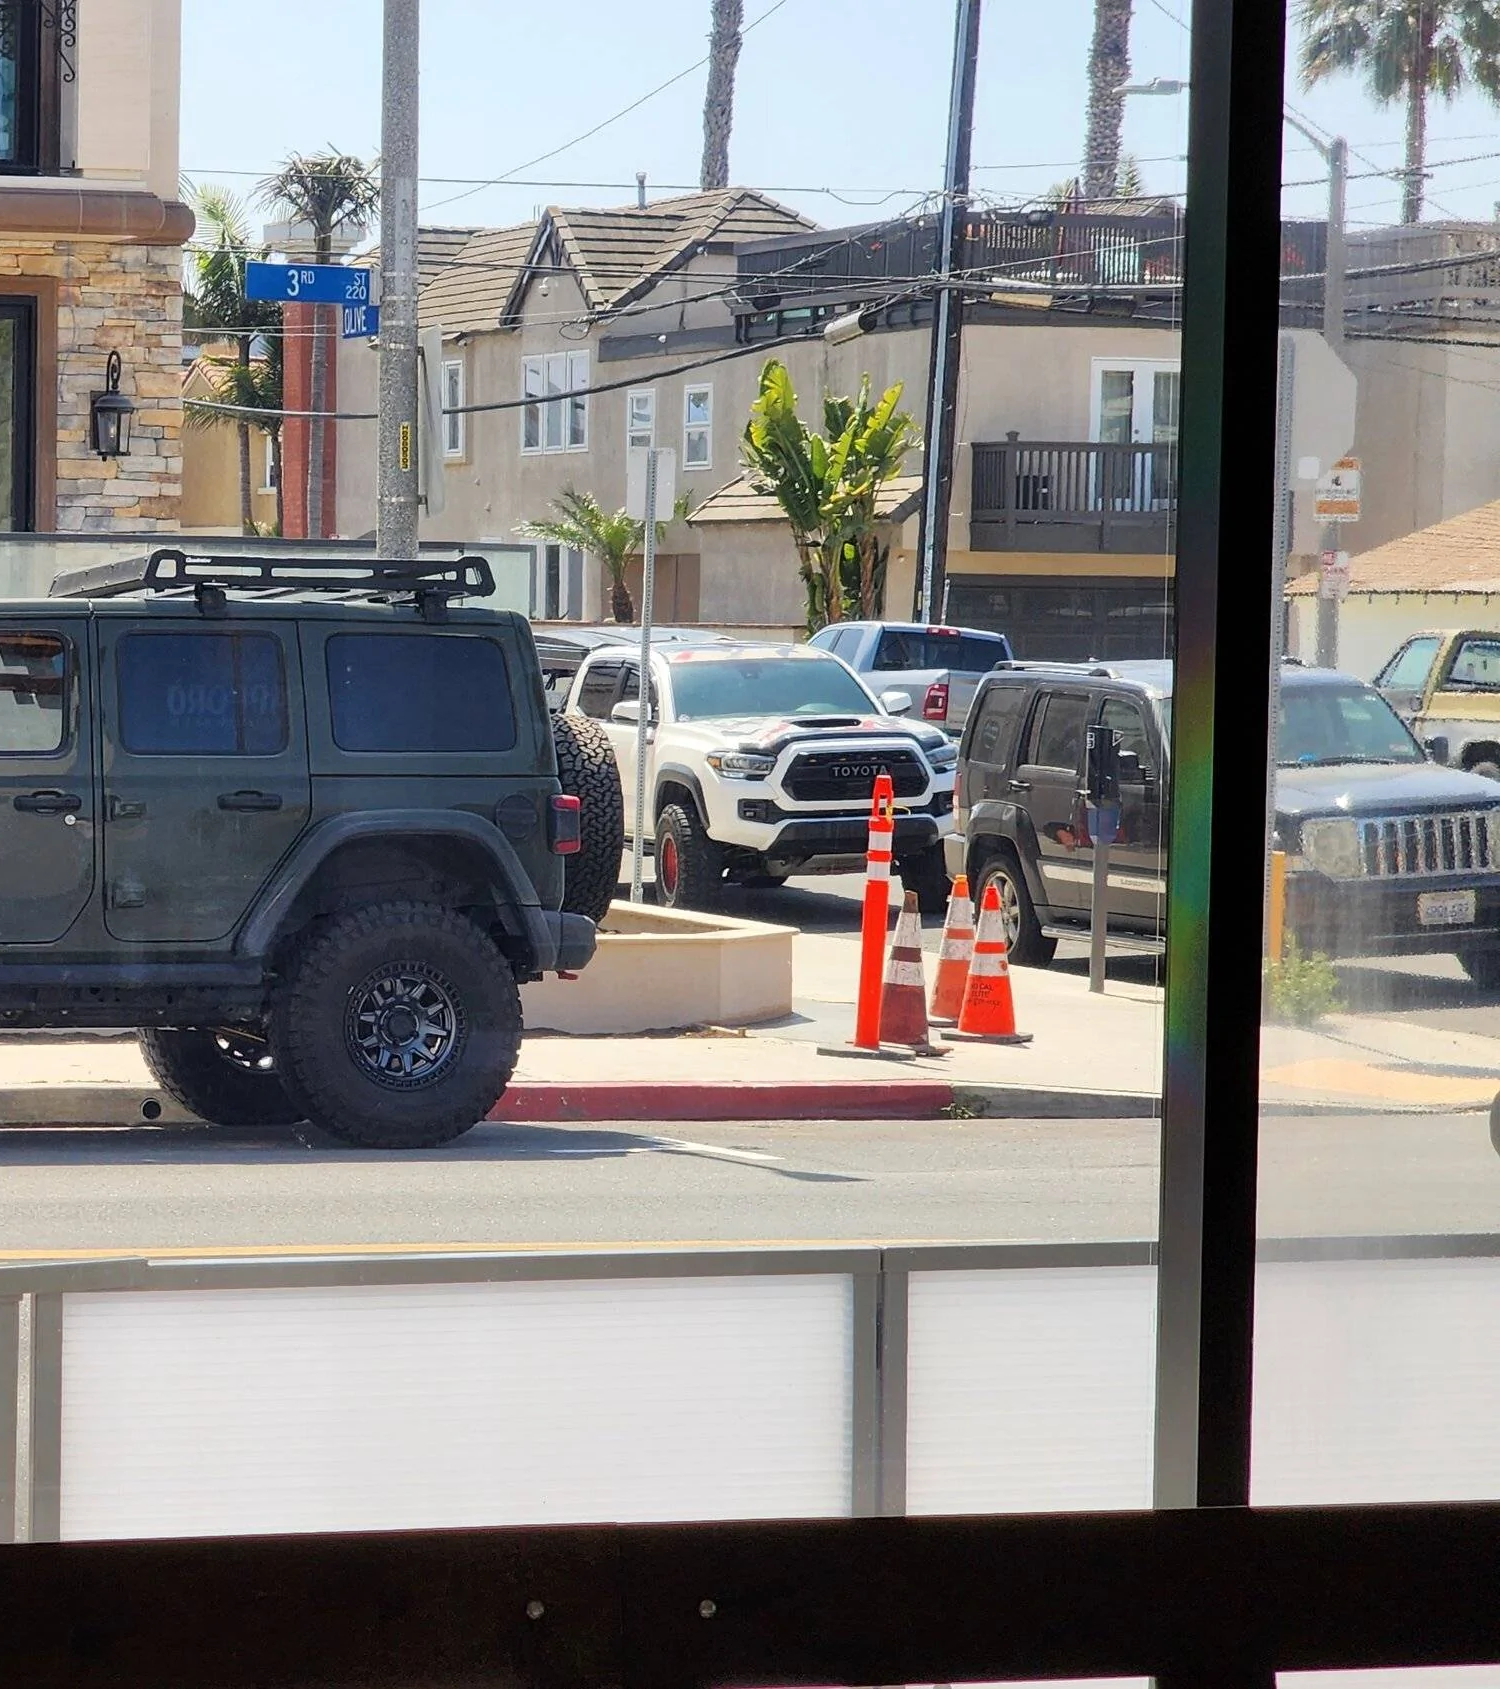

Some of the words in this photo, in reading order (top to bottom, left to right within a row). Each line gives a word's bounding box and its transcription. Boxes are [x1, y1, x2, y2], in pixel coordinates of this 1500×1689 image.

[287, 269, 315, 297] 3RD
[354, 272, 367, 286] ST
[345, 286, 367, 300] 220
[344, 305, 367, 335] OLIVE
[832, 765, 888, 777] TOYOTA
